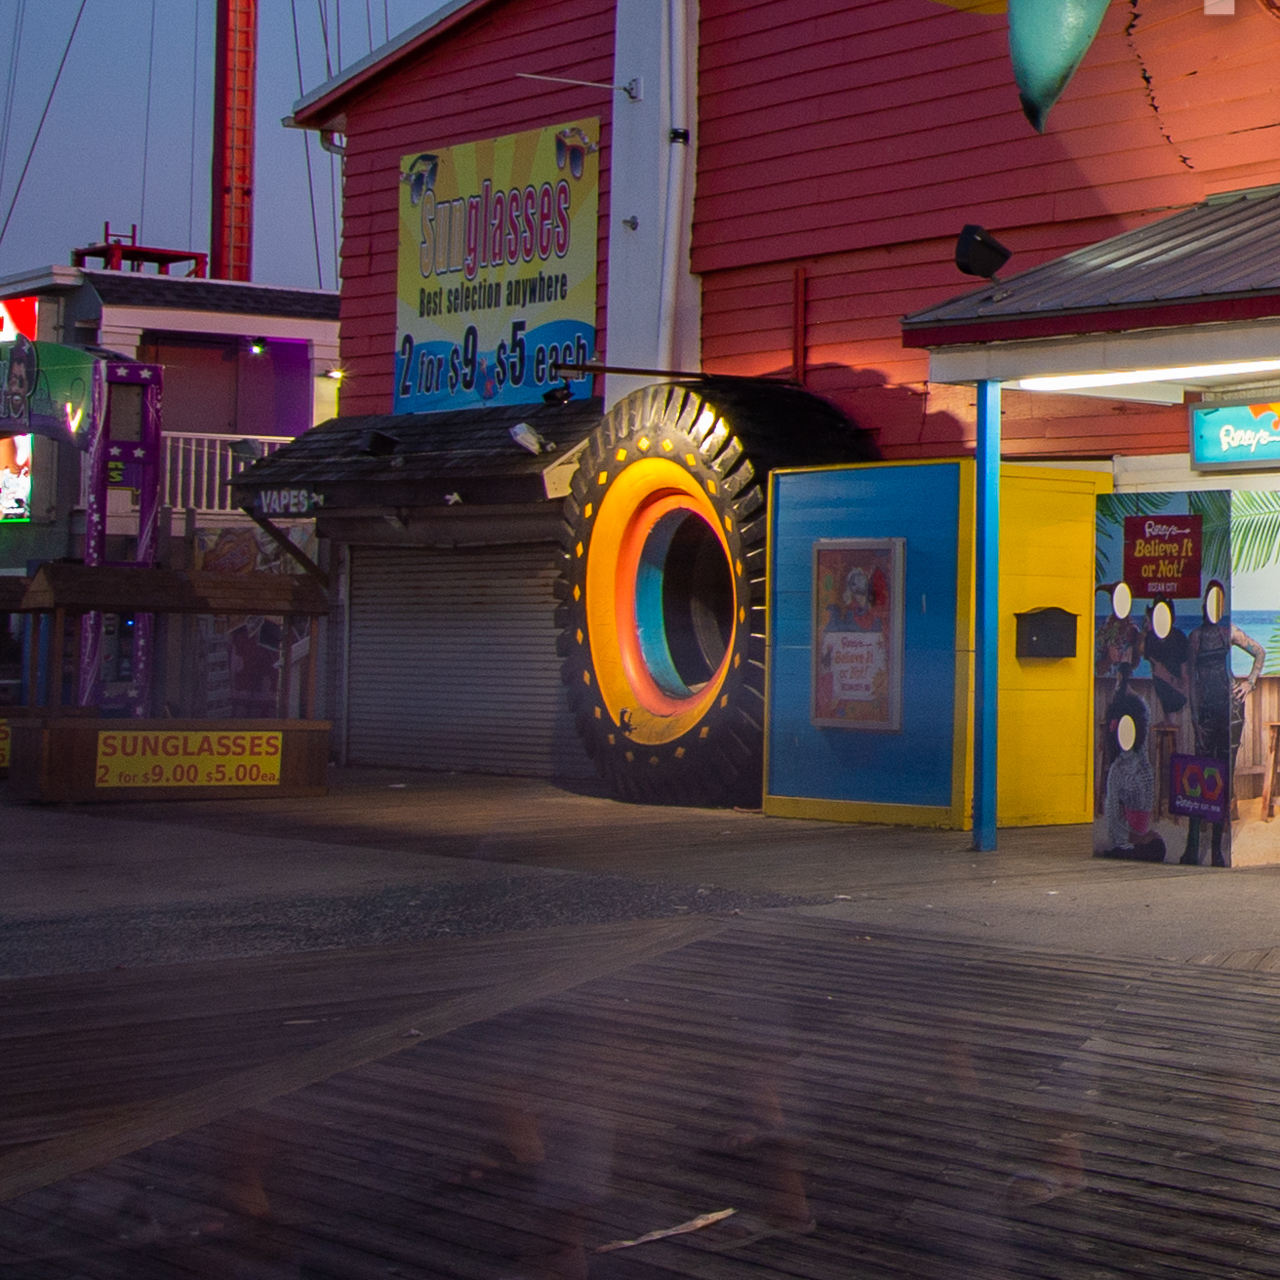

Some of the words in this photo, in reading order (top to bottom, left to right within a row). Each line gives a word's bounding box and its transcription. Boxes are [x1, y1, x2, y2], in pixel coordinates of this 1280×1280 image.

[419, 179, 571, 280] Sunglasses
[419, 287, 443, 317] Best
[447, 279, 501, 314] selection
[506, 273, 568, 308] anywhere
[400, 334, 414, 398] 2
[417, 350, 444, 394] for
[449, 325, 478, 394] $9
[495, 320, 526, 390] $5
[534, 333, 589, 386] each
[260, 490, 308, 513] VAPES
[1134, 539, 1178, 557] Believe
[1181, 538, 1193, 556] It
[1142, 564, 1156, 577] or
[1157, 558, 1185, 577] Not!
[101, 734, 280, 757] SUNGLASSES
[98, 764, 110, 783] 2
[119, 771, 138, 784] for
[142, 764, 199, 783] $9.00
